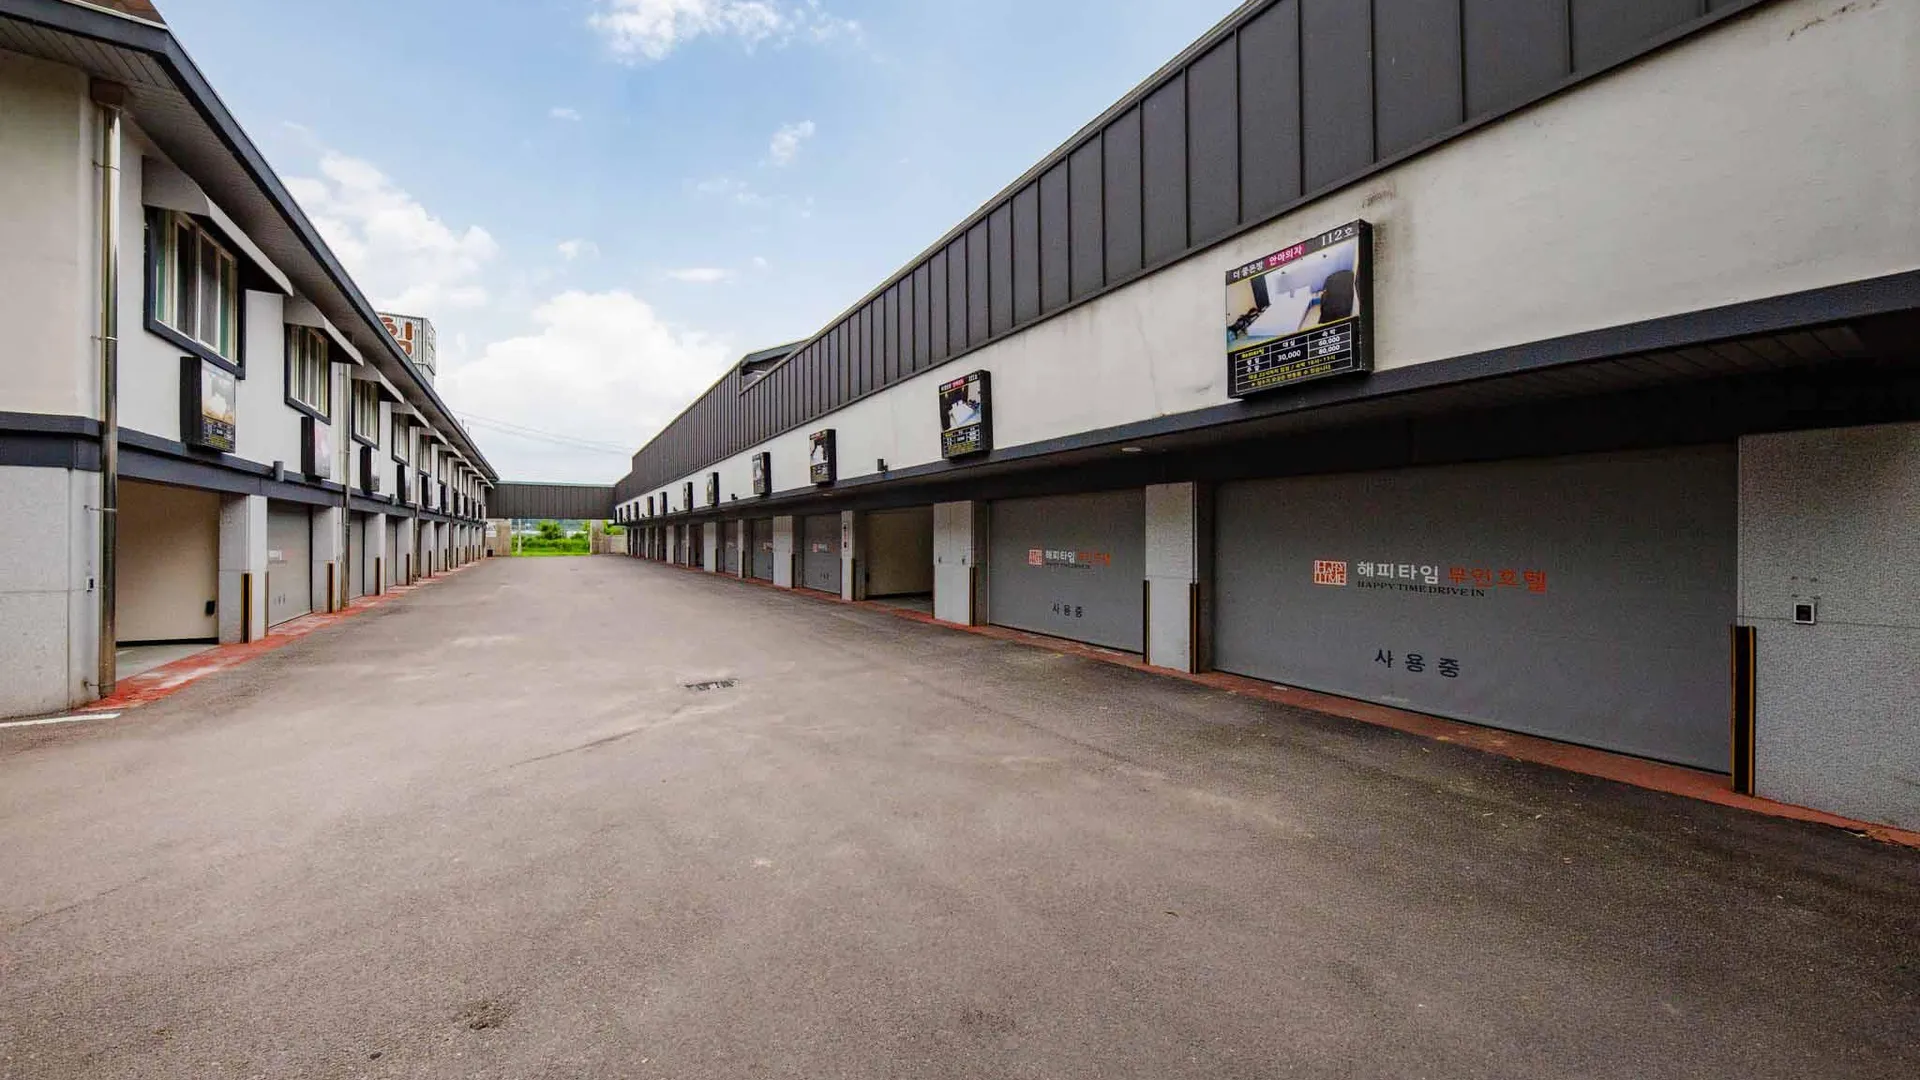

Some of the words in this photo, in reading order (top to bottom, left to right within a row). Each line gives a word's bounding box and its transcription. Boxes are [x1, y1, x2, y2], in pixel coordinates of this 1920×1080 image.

[1269, 245, 1303, 266] 안마의자
[1321, 227, 1354, 246] 112호
[1278, 350, 1301, 361] 30,000
[1357, 561, 1440, 585] 해피타임
